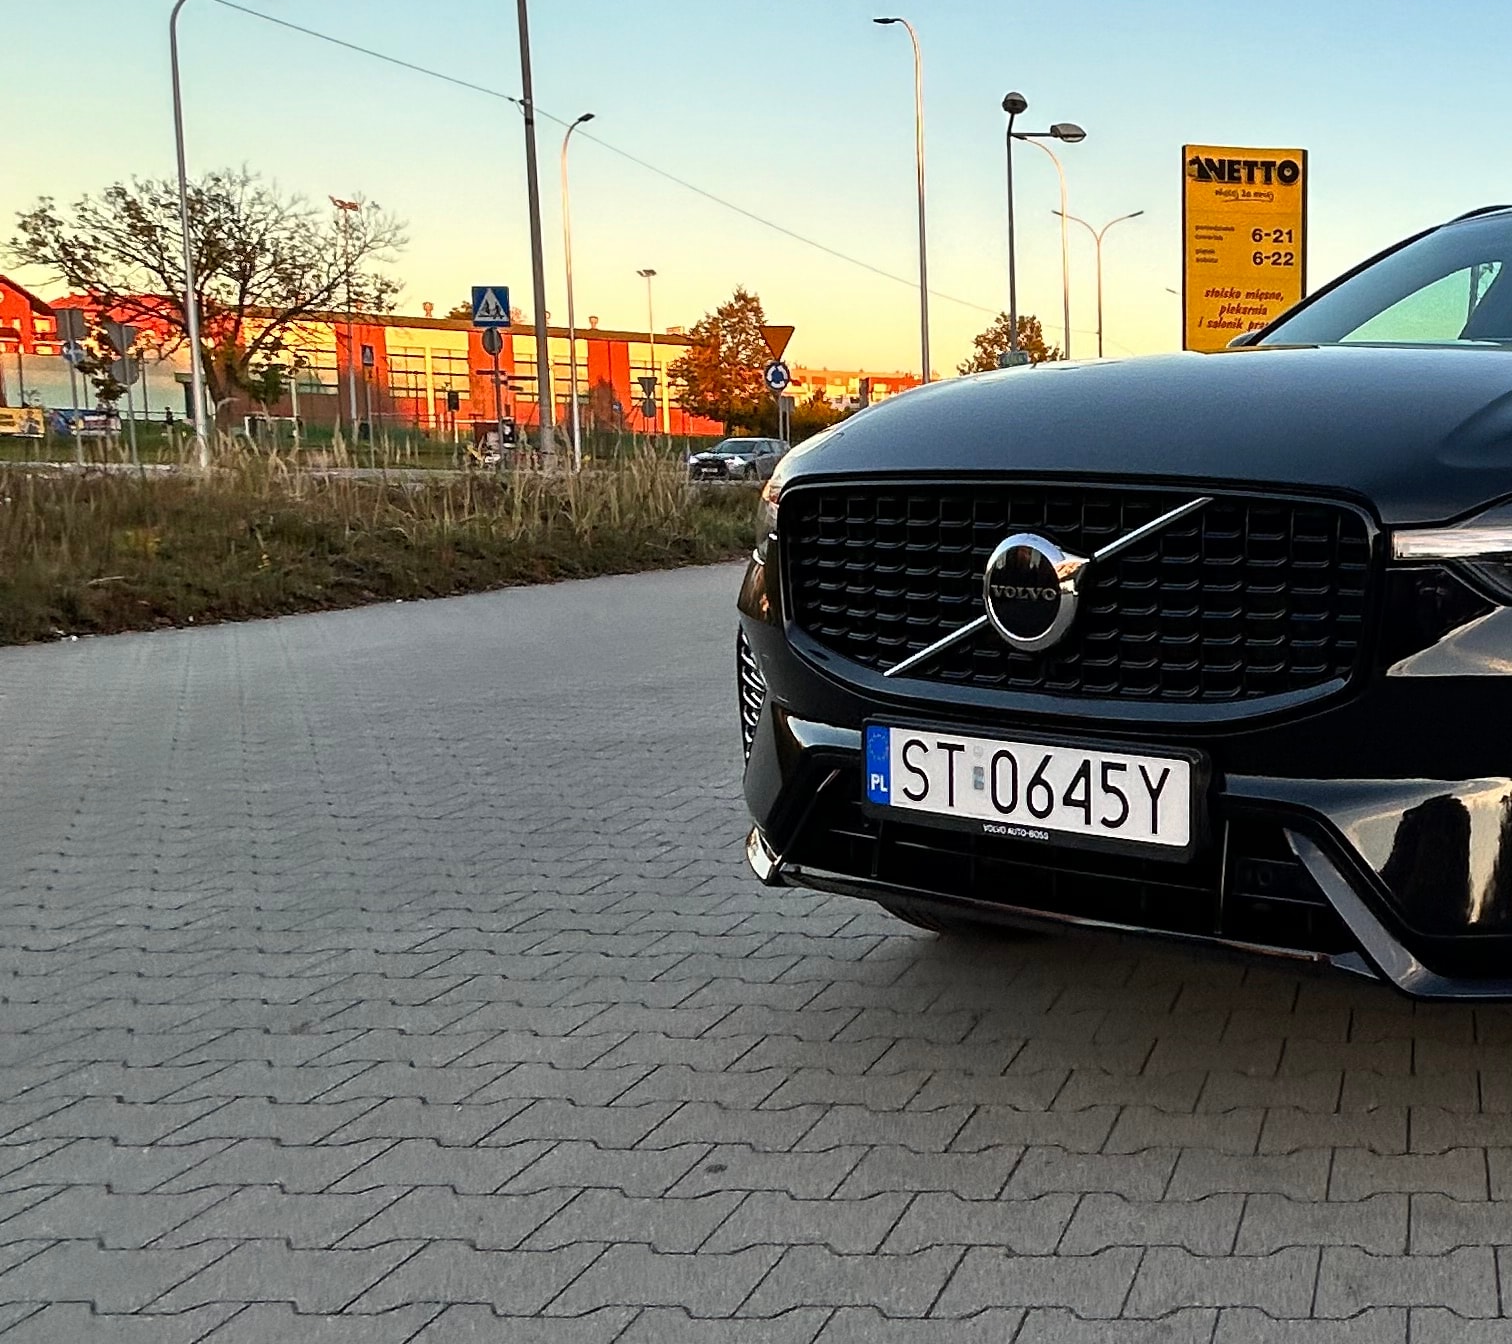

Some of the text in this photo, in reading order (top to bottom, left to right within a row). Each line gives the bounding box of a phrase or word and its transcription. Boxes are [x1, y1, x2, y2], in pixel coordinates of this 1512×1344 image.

[1204, 158, 1300, 185] NETTO
[1251, 228, 1293, 243] 6-21
[1252, 251, 1294, 266] 6-22
[1218, 303, 1268, 317] piekarnia
[1207, 317, 1243, 329] salonik
[990, 584, 1057, 601] VOLVO
[871, 773, 888, 792] PL
[902, 738, 1172, 836] ST 0645Y
[983, 824, 1007, 835] VOLVO
